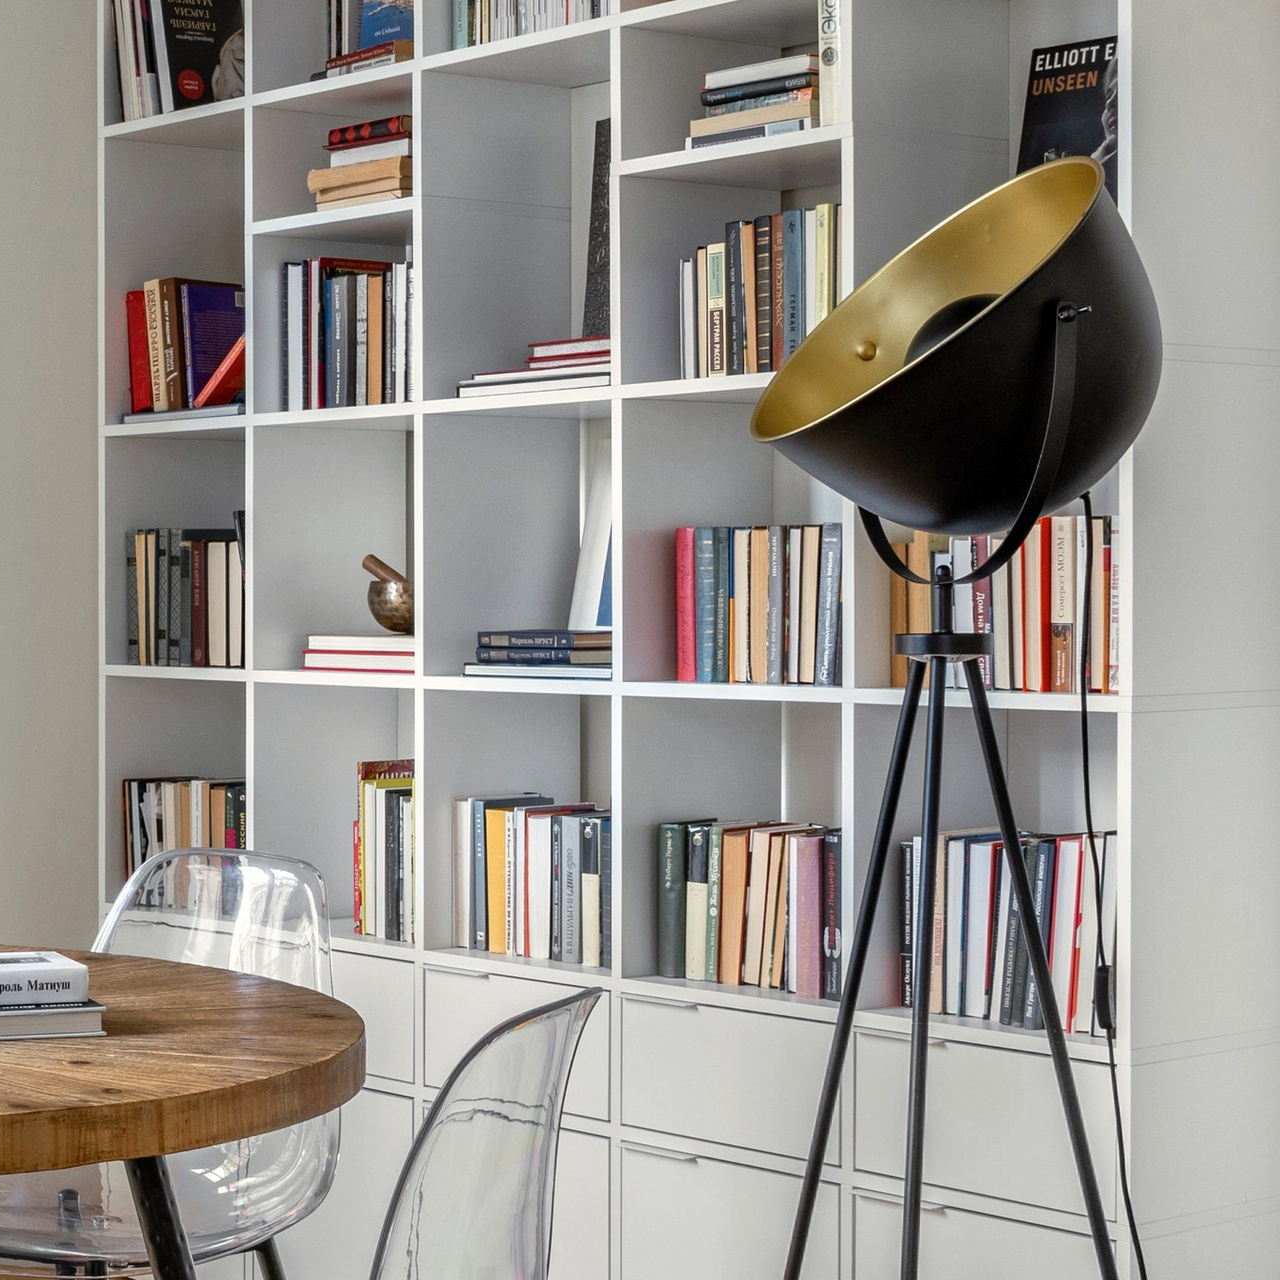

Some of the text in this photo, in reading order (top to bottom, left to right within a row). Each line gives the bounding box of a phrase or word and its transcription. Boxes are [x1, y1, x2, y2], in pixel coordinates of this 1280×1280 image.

[170, 18, 216, 32] ГАБРИЭЛЬ
[174, 7, 210, 19] ГАРСИА
[1035, 42, 1118, 72] ELLIOTT E
[1032, 70, 1098, 96] UNSEEN
[788, 294, 796, 332] ГЕРМАН
[712, 310, 722, 370] БЕРТРАН РАССЕЛ
[150, 331, 162, 404] ШАРЛЬ ПЕРРО
[1055, 536, 1066, 619] Сомерсет МОЭМ
[975, 591, 985, 628] Дом на
[238, 811, 246, 850] УССКИЙ
[827, 852, 836, 949] Эффект Люцифера
[1034, 853, 1046, 916] РОССИЙСКОЙ ИМПЕРИИ
[566, 893, 575, 940] ШУЛЬГИН
[27, 979, 72, 995] Матиуш
[904, 984, 912, 1006] Андерс
